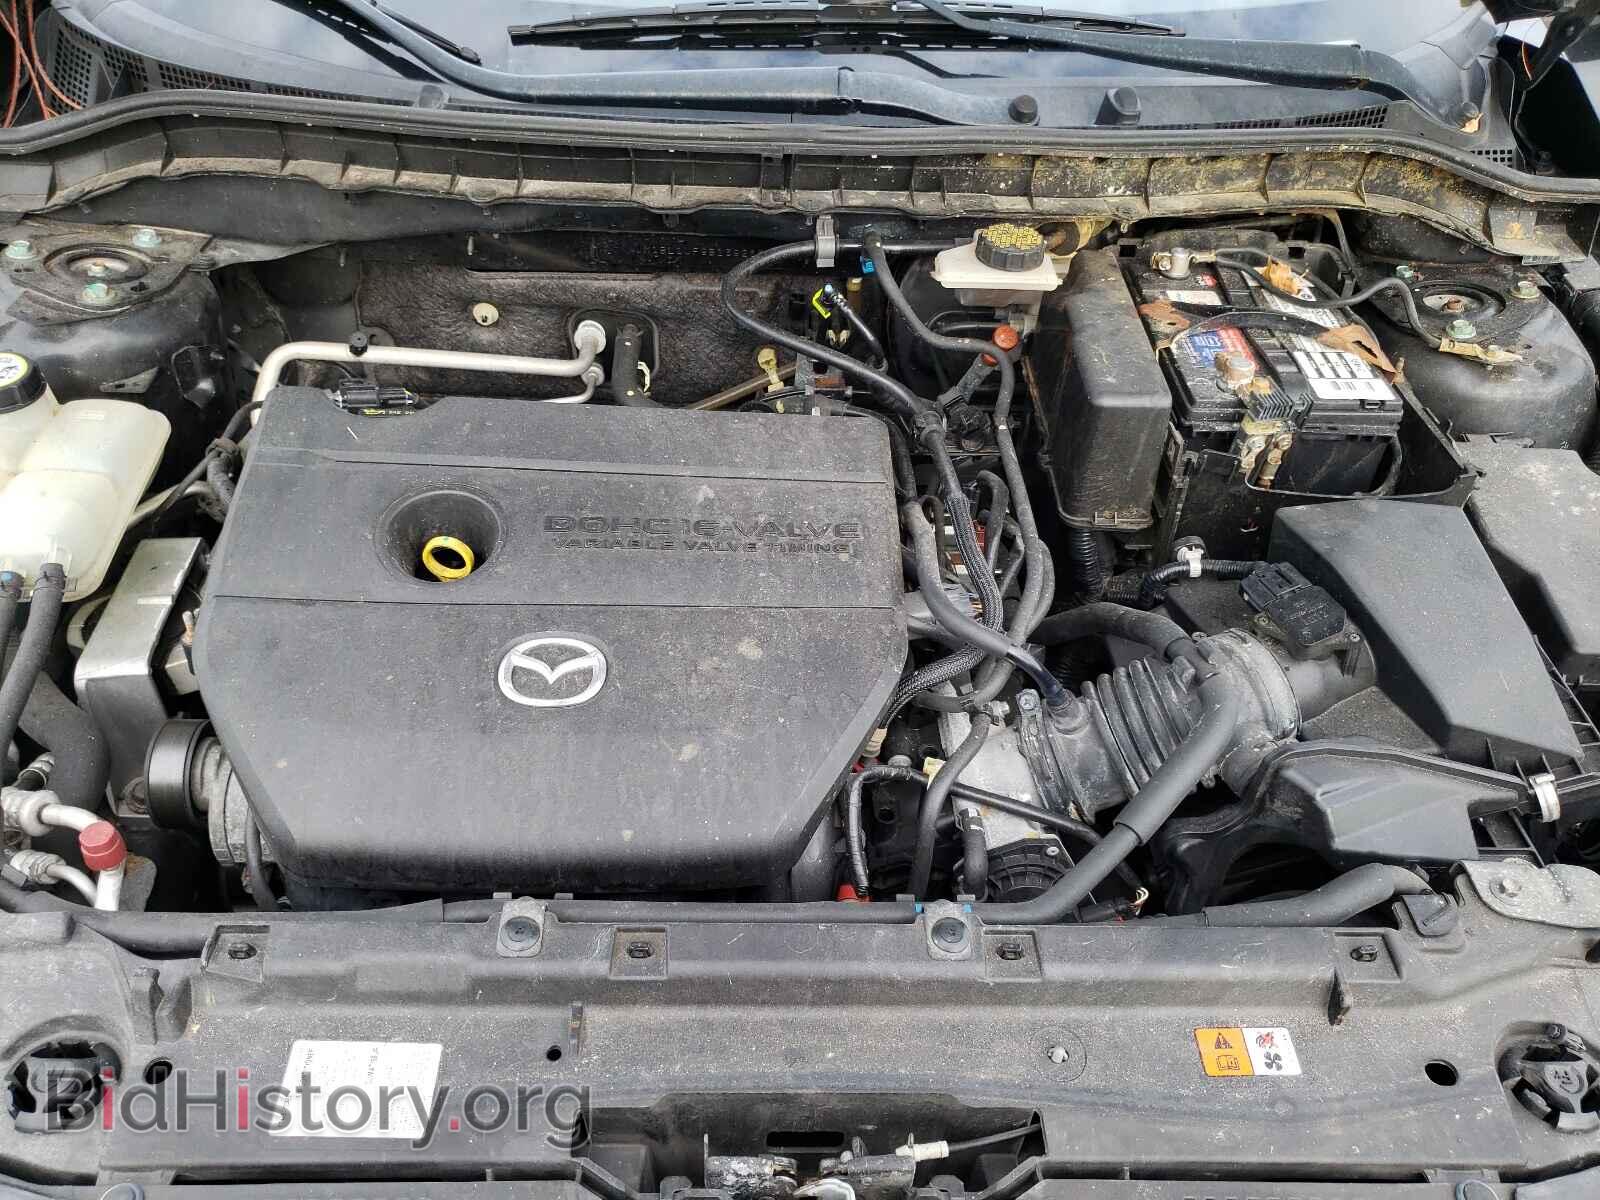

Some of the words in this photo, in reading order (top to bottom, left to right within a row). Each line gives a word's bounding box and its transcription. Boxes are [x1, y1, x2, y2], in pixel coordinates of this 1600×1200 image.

[543, 514, 672, 535] DOHC
[553, 538, 676, 551] VARIABLE
[682, 540, 758, 553] VALVE
[766, 542, 851, 554] TIMING
